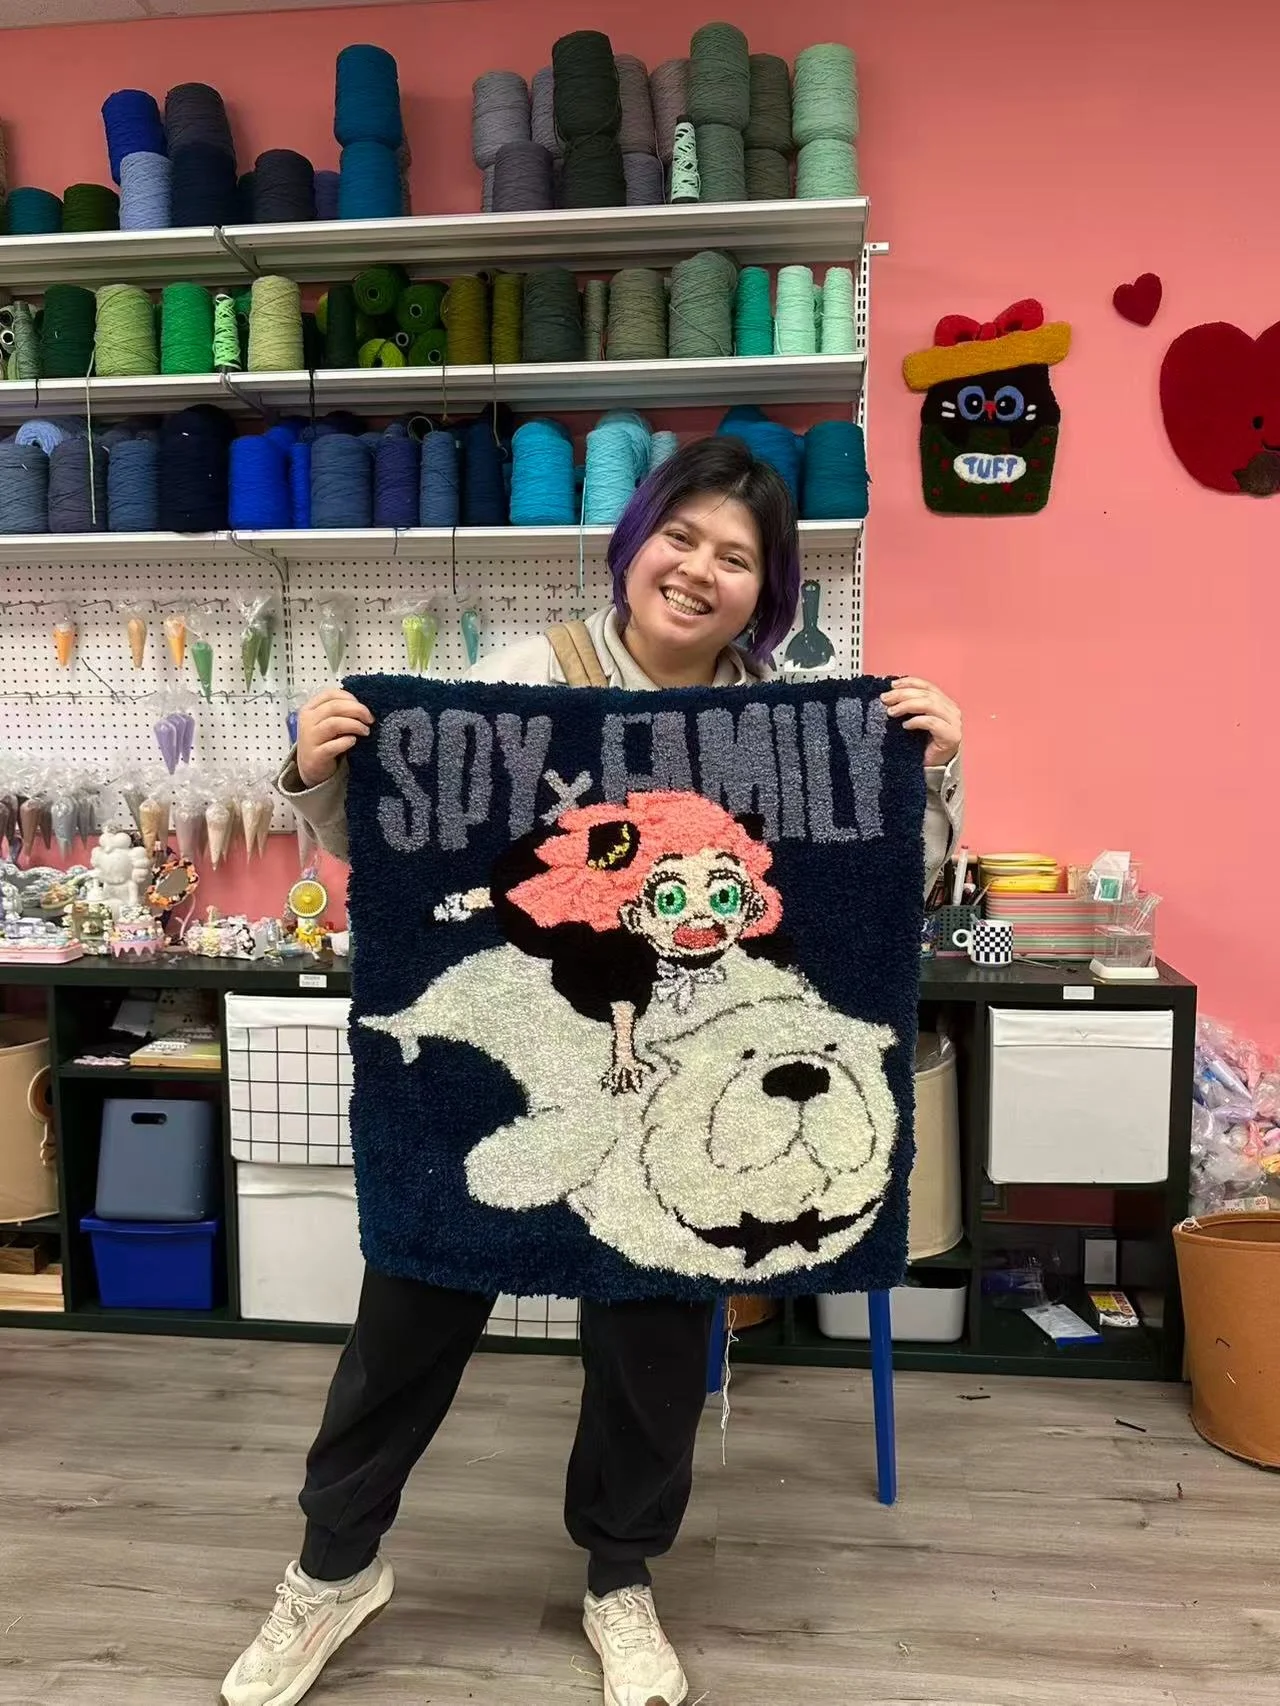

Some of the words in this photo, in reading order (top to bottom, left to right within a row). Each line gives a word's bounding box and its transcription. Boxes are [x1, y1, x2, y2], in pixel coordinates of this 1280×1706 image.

[963, 456, 1018, 479] TUFT
[377, 706, 553, 853] SPY
[601, 698, 887, 844] FAMILY
